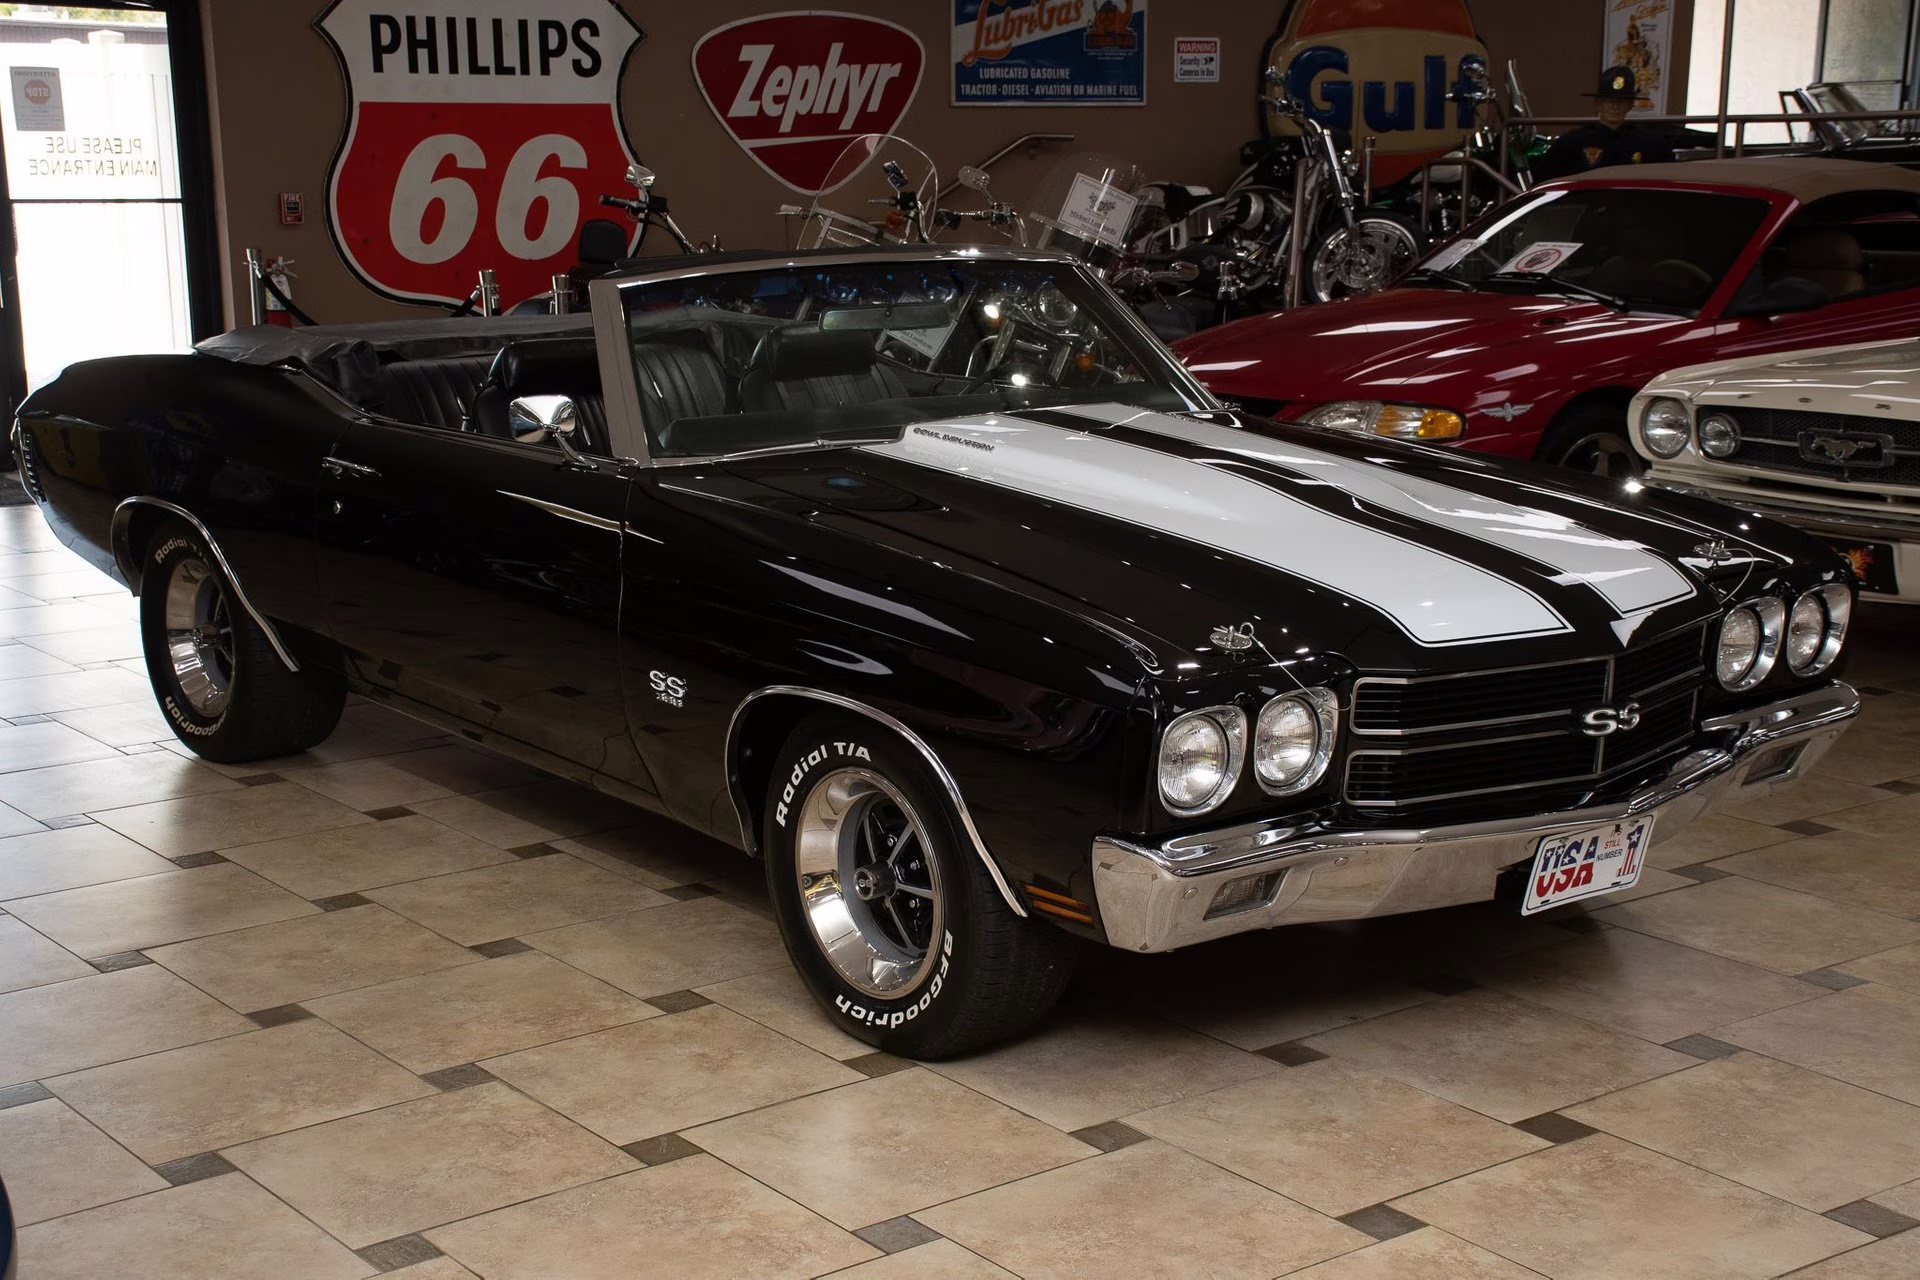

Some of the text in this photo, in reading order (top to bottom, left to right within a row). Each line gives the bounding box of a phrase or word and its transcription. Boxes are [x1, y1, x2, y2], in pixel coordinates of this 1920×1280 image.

[369, 14, 601, 78] PHILLIPS
[1179, 42, 1216, 53] WARNING
[1180, 56, 1200, 66] Security
[727, 42, 903, 133] Zephyr
[979, 67, 1070, 80] LUBRICATED GASOLINE
[1286, 45, 1486, 133] Gulf
[960, 84, 998, 96] TRACTOR
[1034, 85, 1072, 96] AVIATION
[1073, 85, 1085, 96] OR
[1086, 85, 1118, 97] MARINE
[1119, 85, 1138, 97] FUEL
[388, 134, 588, 265] 66
[154, 537, 188, 565] Radial
[649, 670, 685, 698] SS
[1583, 703, 1640, 737] SS
[775, 744, 828, 828] Radial
[1595, 849, 1623, 862] NUMBER
[1604, 839, 1621, 850] STILL
[1536, 835, 1600, 898] USA
[836, 929, 954, 1029] BFGoodrich
